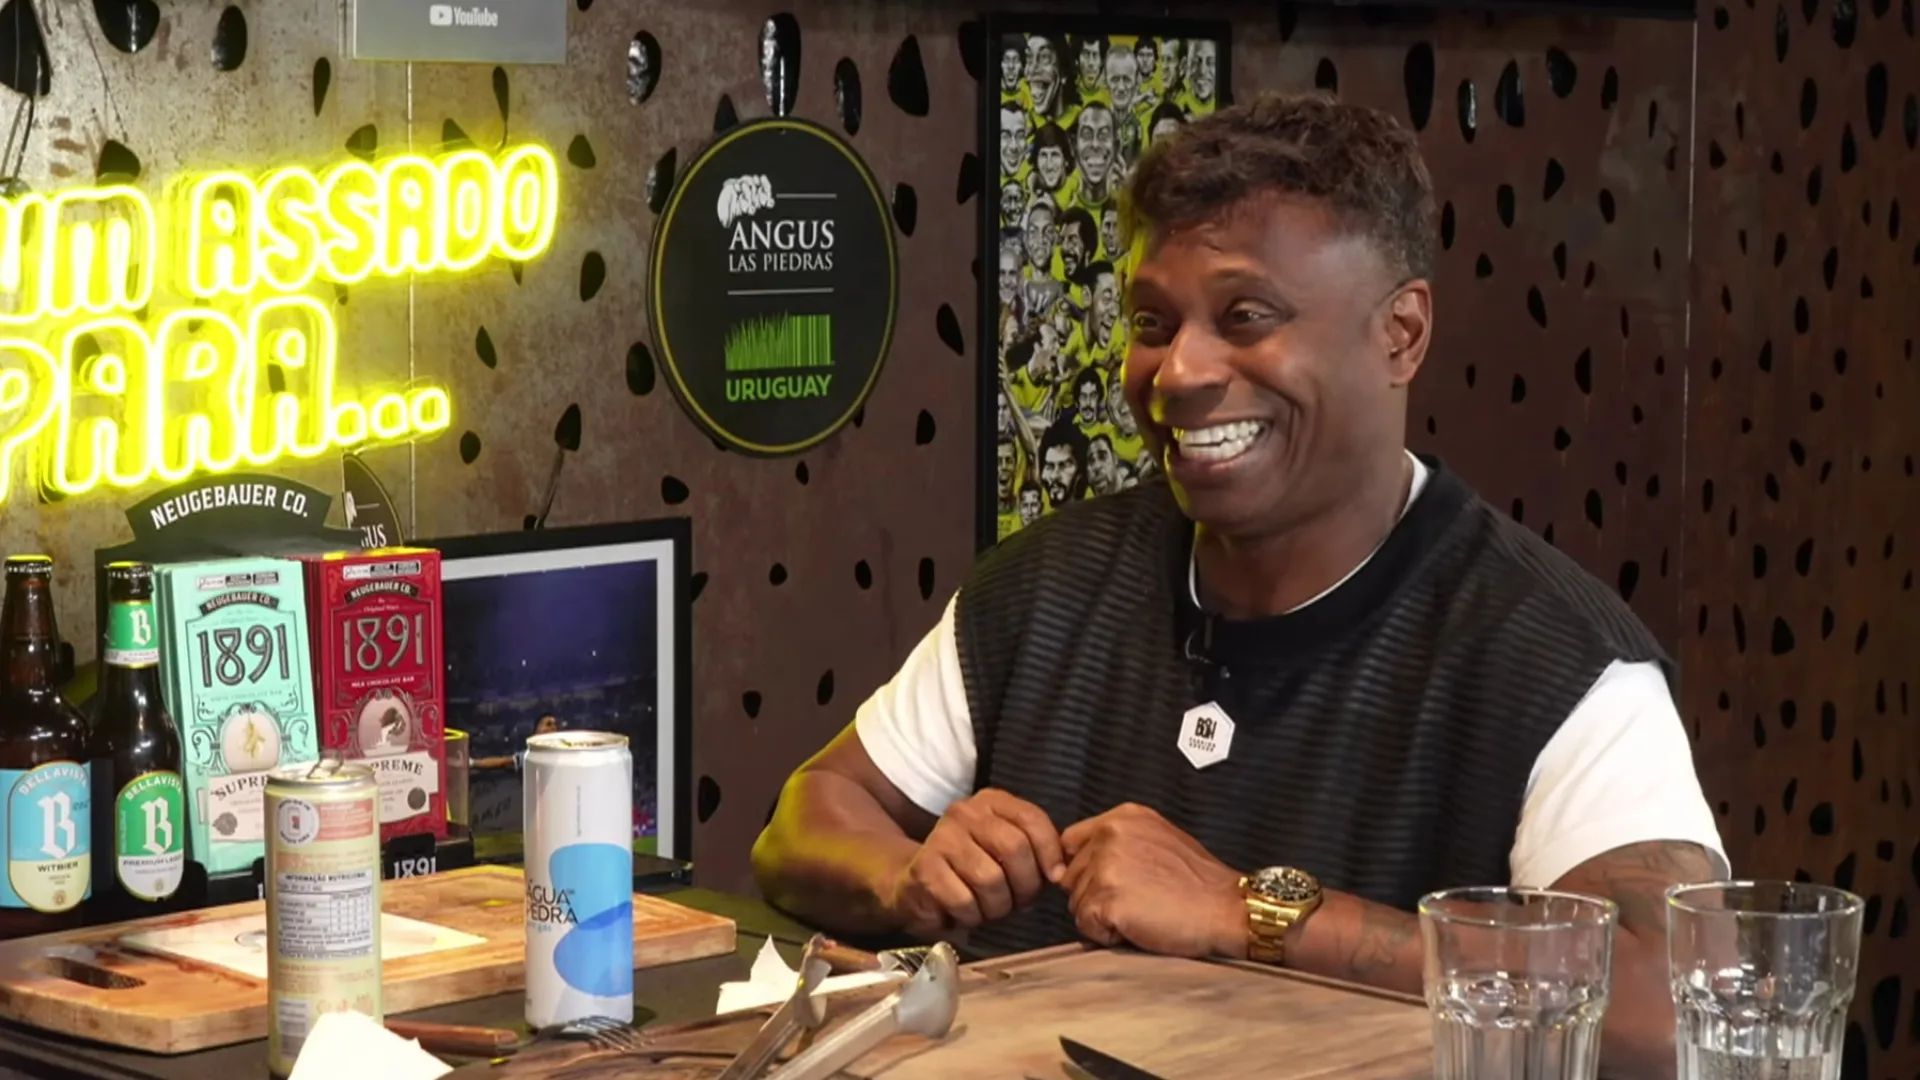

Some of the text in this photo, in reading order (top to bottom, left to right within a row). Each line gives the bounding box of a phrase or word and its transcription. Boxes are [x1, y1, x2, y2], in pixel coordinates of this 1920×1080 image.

[453, 6, 498, 26] YouTube
[187, 145, 558, 297] ASSADO
[729, 219, 835, 250] ANGUS
[729, 251, 834, 273] LAS PIEDRAS
[725, 374, 832, 401] URUGUAY
[150, 484, 309, 530] NEUGEBAUER CO.
[206, 591, 258, 611] NEUGEBAUER
[129, 608, 152, 646] B
[342, 612, 424, 673] 1891
[196, 622, 290, 688] 1891
[37, 790, 76, 859] B
[140, 796, 173, 856] B
[37, 861, 79, 873] WITBIER
